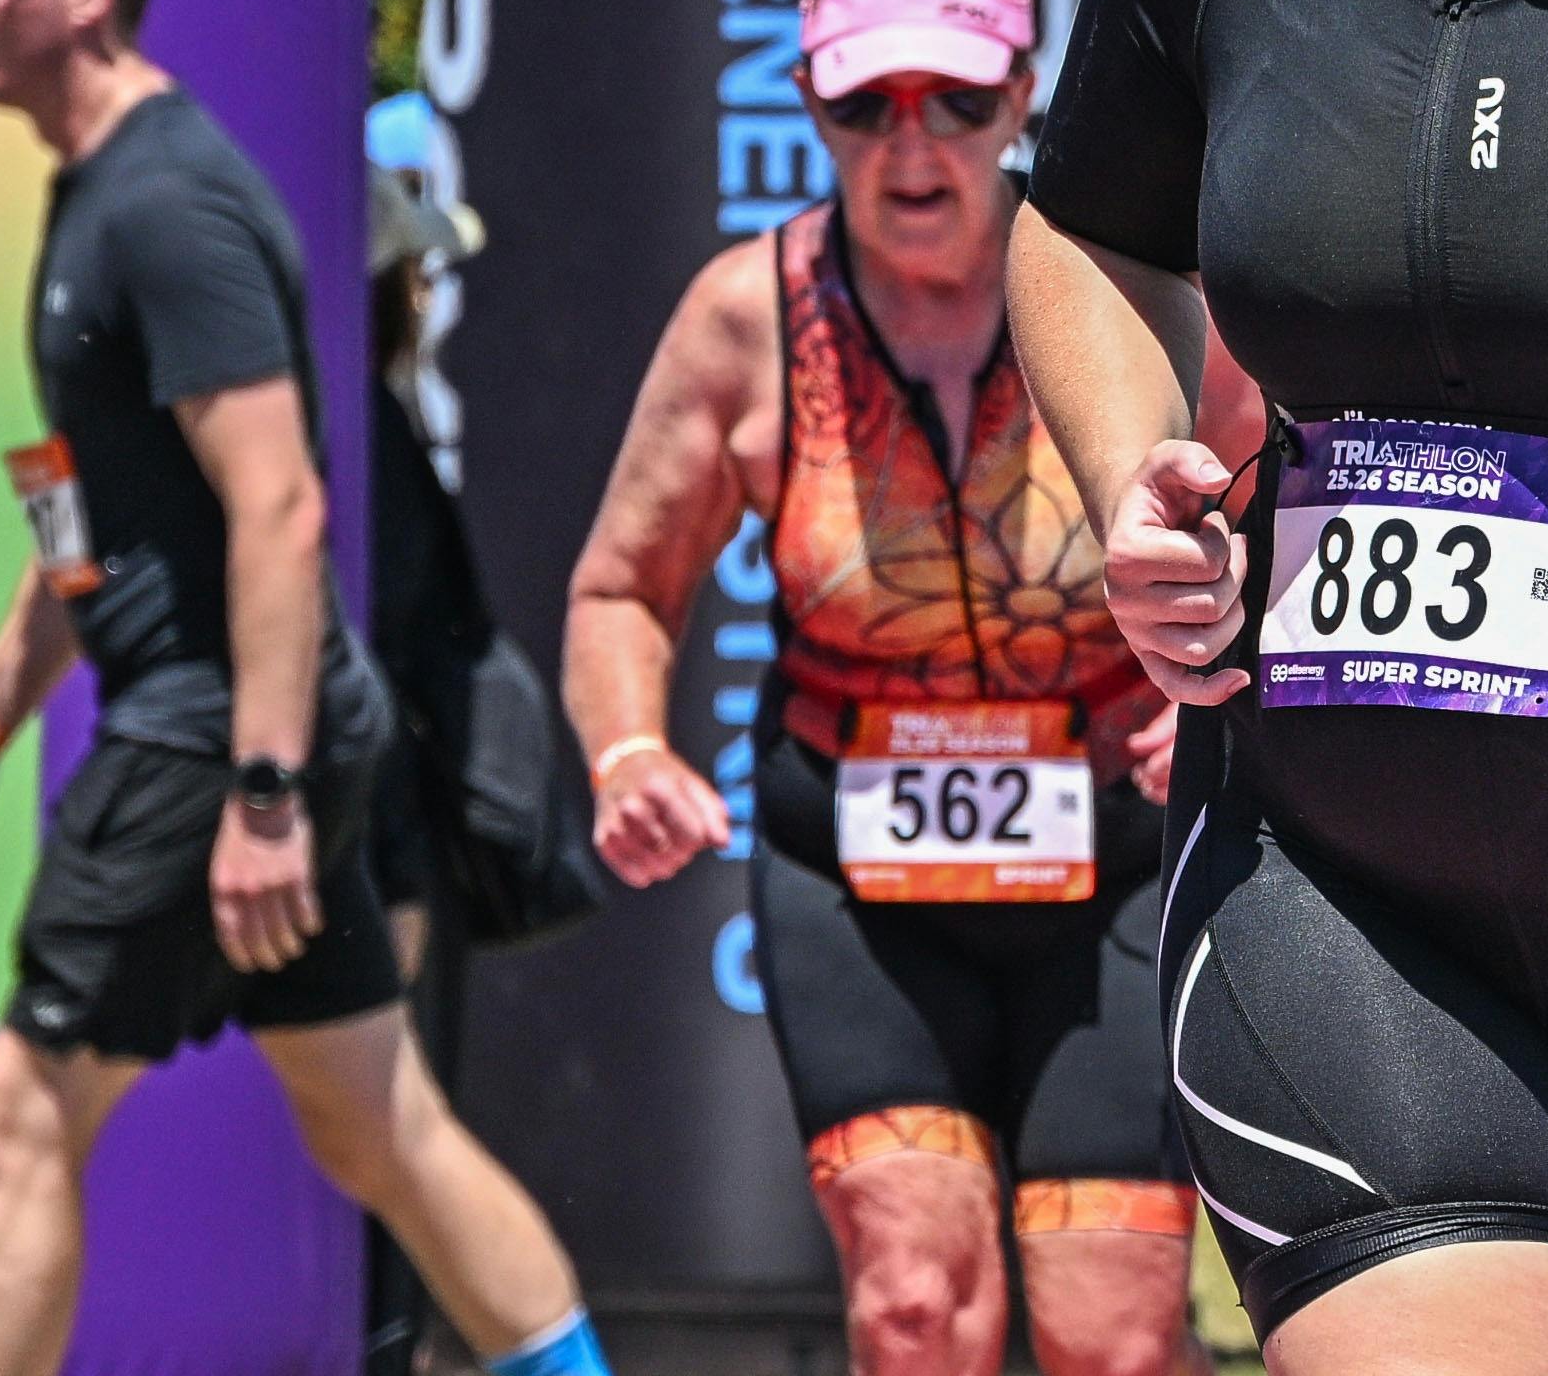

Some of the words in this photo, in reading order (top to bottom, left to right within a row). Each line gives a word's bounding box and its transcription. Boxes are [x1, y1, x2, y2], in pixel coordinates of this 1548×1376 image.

[1470, 77, 1506, 170] 2XU
[1327, 469, 1384, 491] 25.26
[1387, 469, 1502, 502] SEASON
[1332, 440, 1507, 478] TRIATHLON
[1310, 517, 1492, 642] 883
[1342, 660, 1417, 686] SUPER
[1423, 666, 1532, 698] SPRINT
[889, 766, 1032, 844] 562
